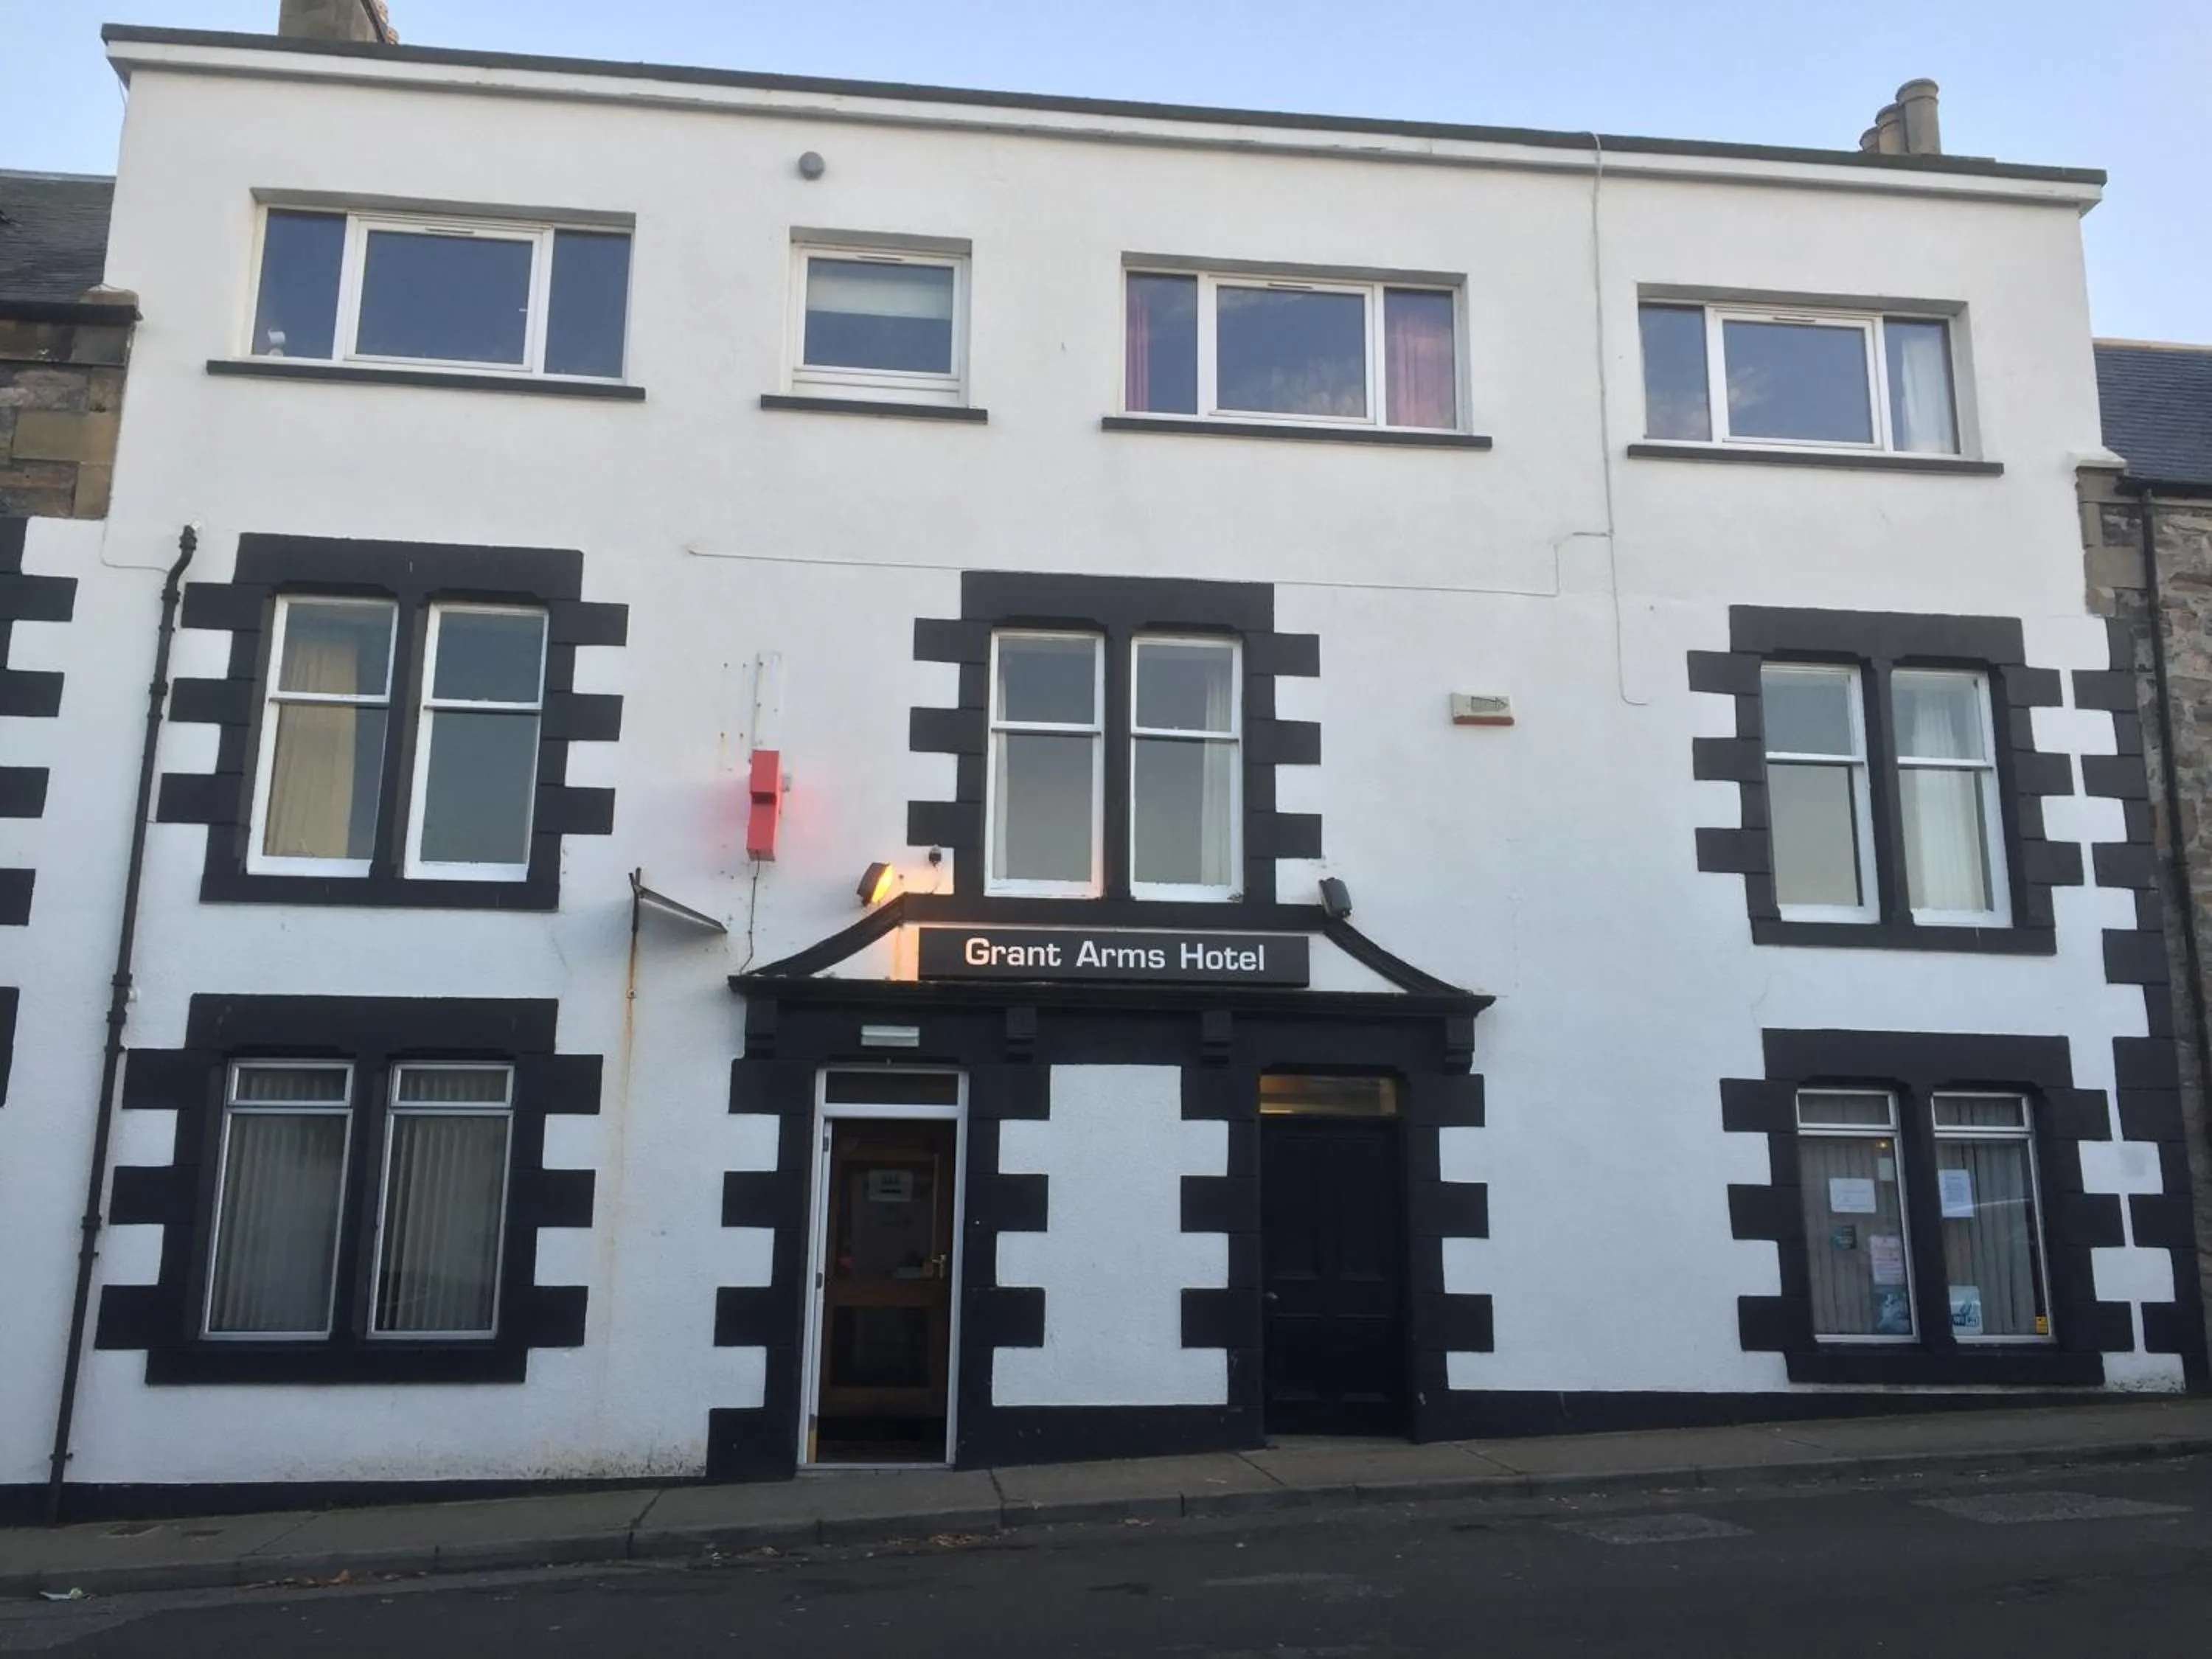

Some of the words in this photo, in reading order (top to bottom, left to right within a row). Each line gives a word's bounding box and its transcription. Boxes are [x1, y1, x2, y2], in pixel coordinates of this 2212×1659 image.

[965, 937, 1062, 967] Grant
[1076, 940, 1166, 968] Arms
[1180, 943, 1265, 971] Hotel
